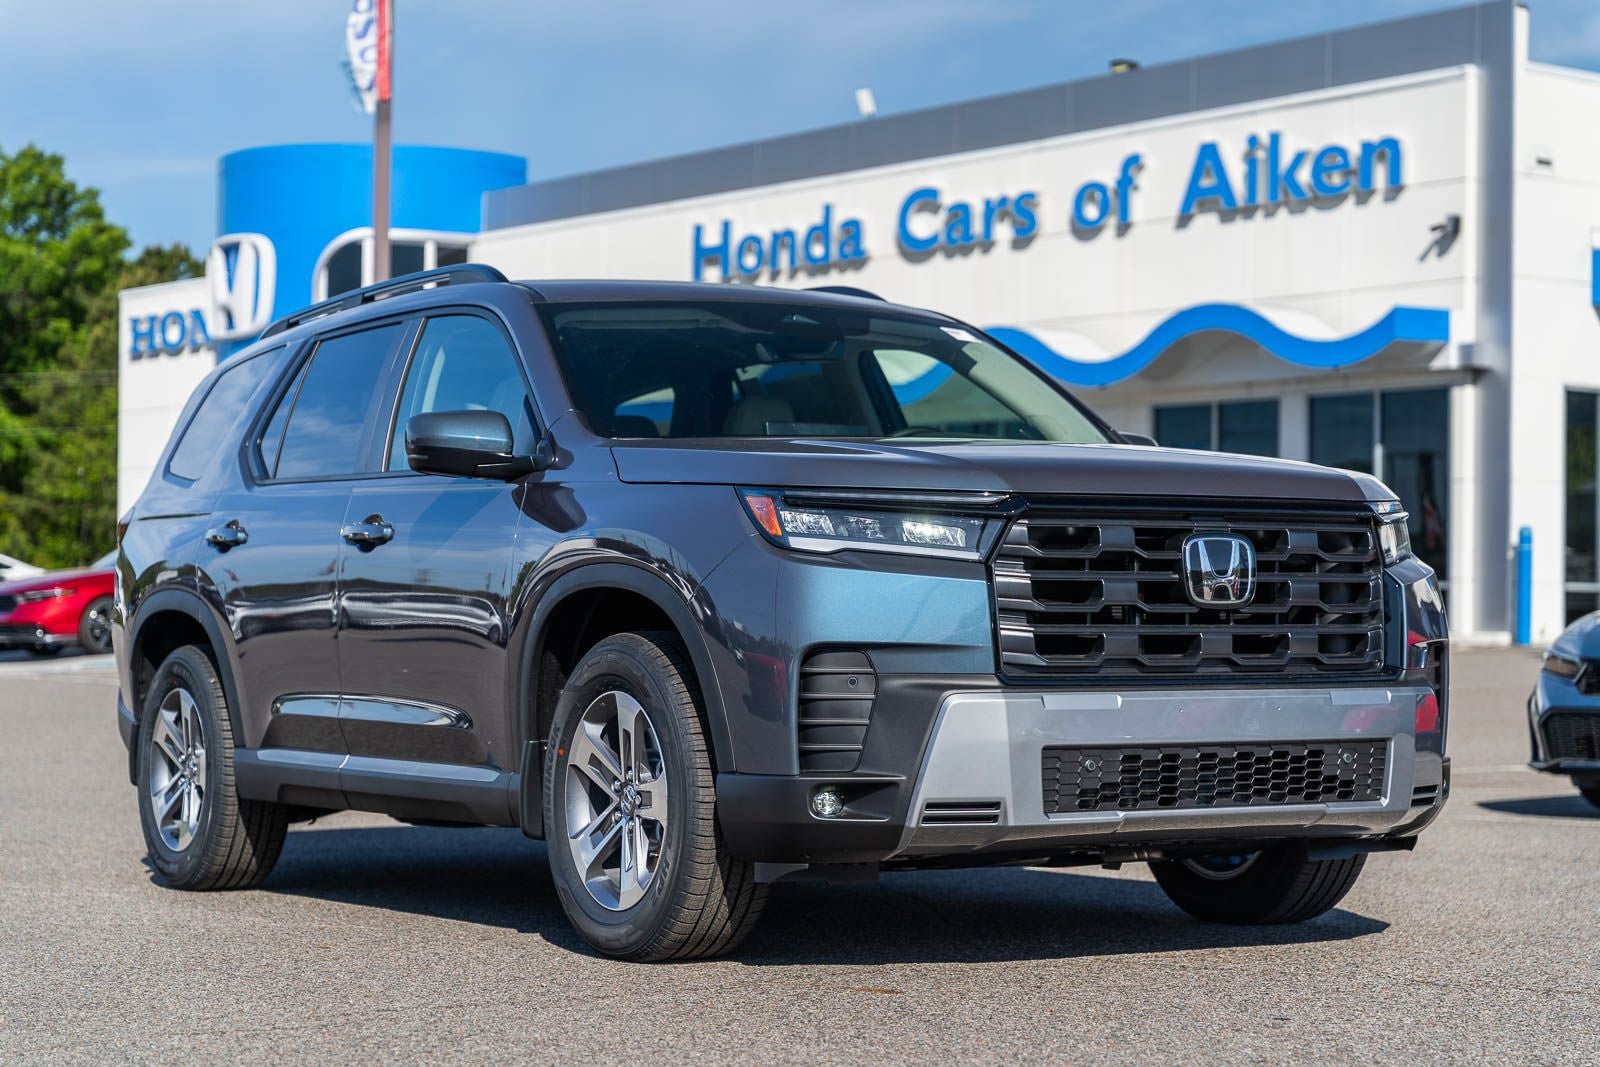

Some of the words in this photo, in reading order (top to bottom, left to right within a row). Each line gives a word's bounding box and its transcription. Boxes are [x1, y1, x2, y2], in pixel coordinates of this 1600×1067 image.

[693, 202, 866, 282] Honda
[899, 187, 1038, 252] Cars
[1073, 153, 1141, 228] of
[1178, 131, 1403, 216] Aiken
